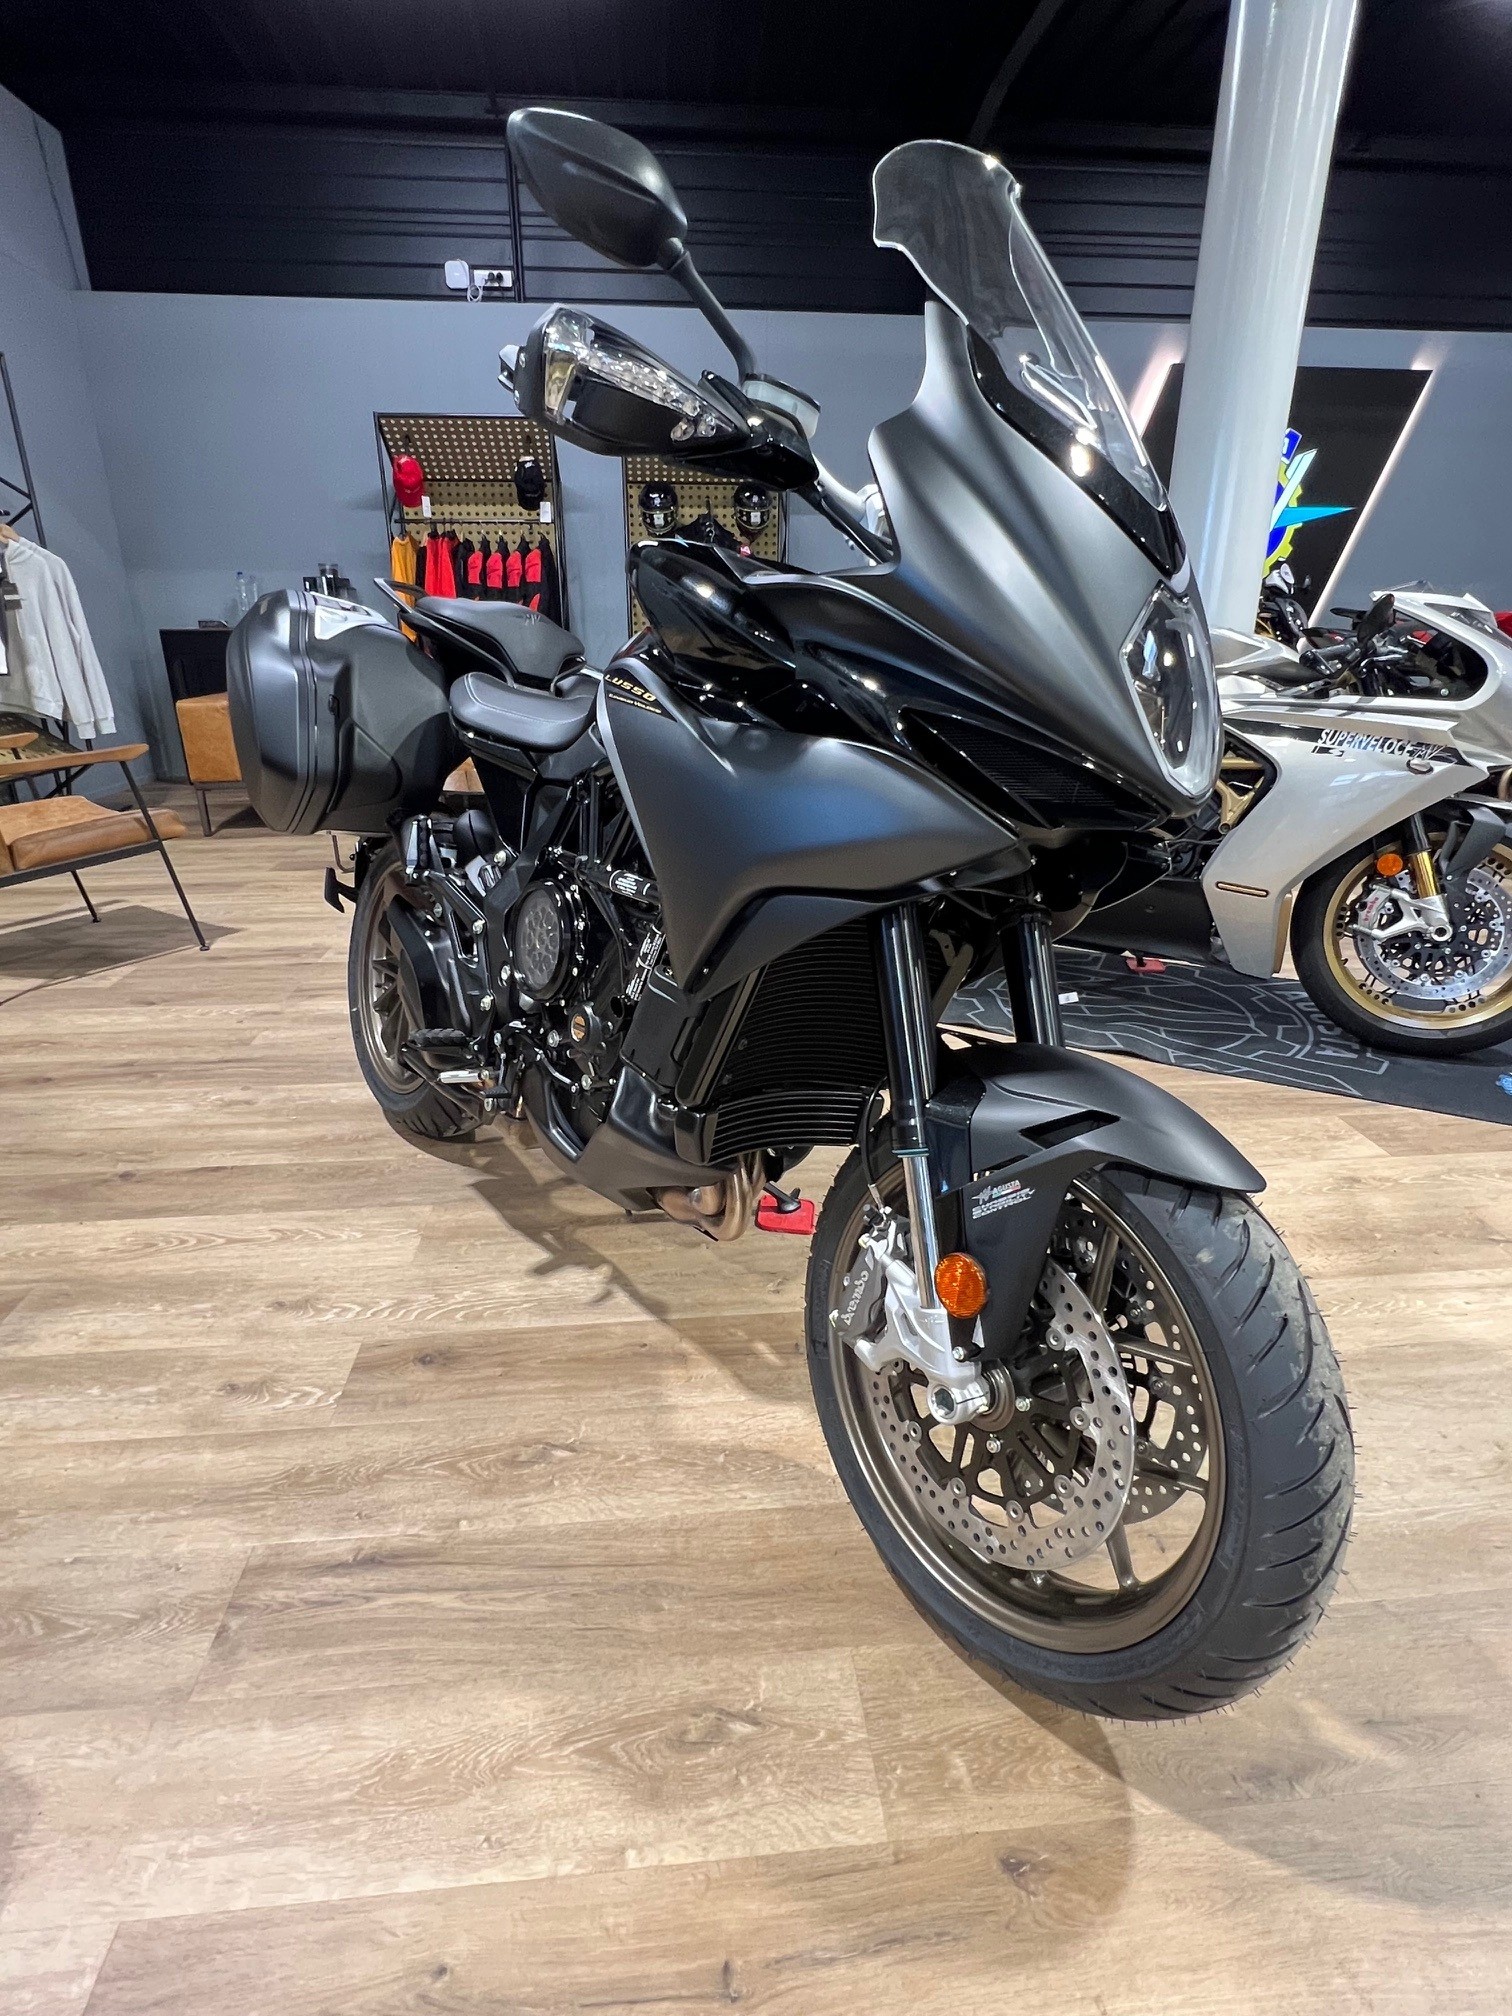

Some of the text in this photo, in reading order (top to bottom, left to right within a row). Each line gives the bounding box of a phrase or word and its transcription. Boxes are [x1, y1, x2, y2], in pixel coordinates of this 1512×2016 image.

[604, 674, 657, 702] LUSSO
[1317, 728, 1416, 758] SUPERVELOCE
[991, 1179, 1021, 1199] AGUSTA
[840, 1270, 870, 1326] brembo
